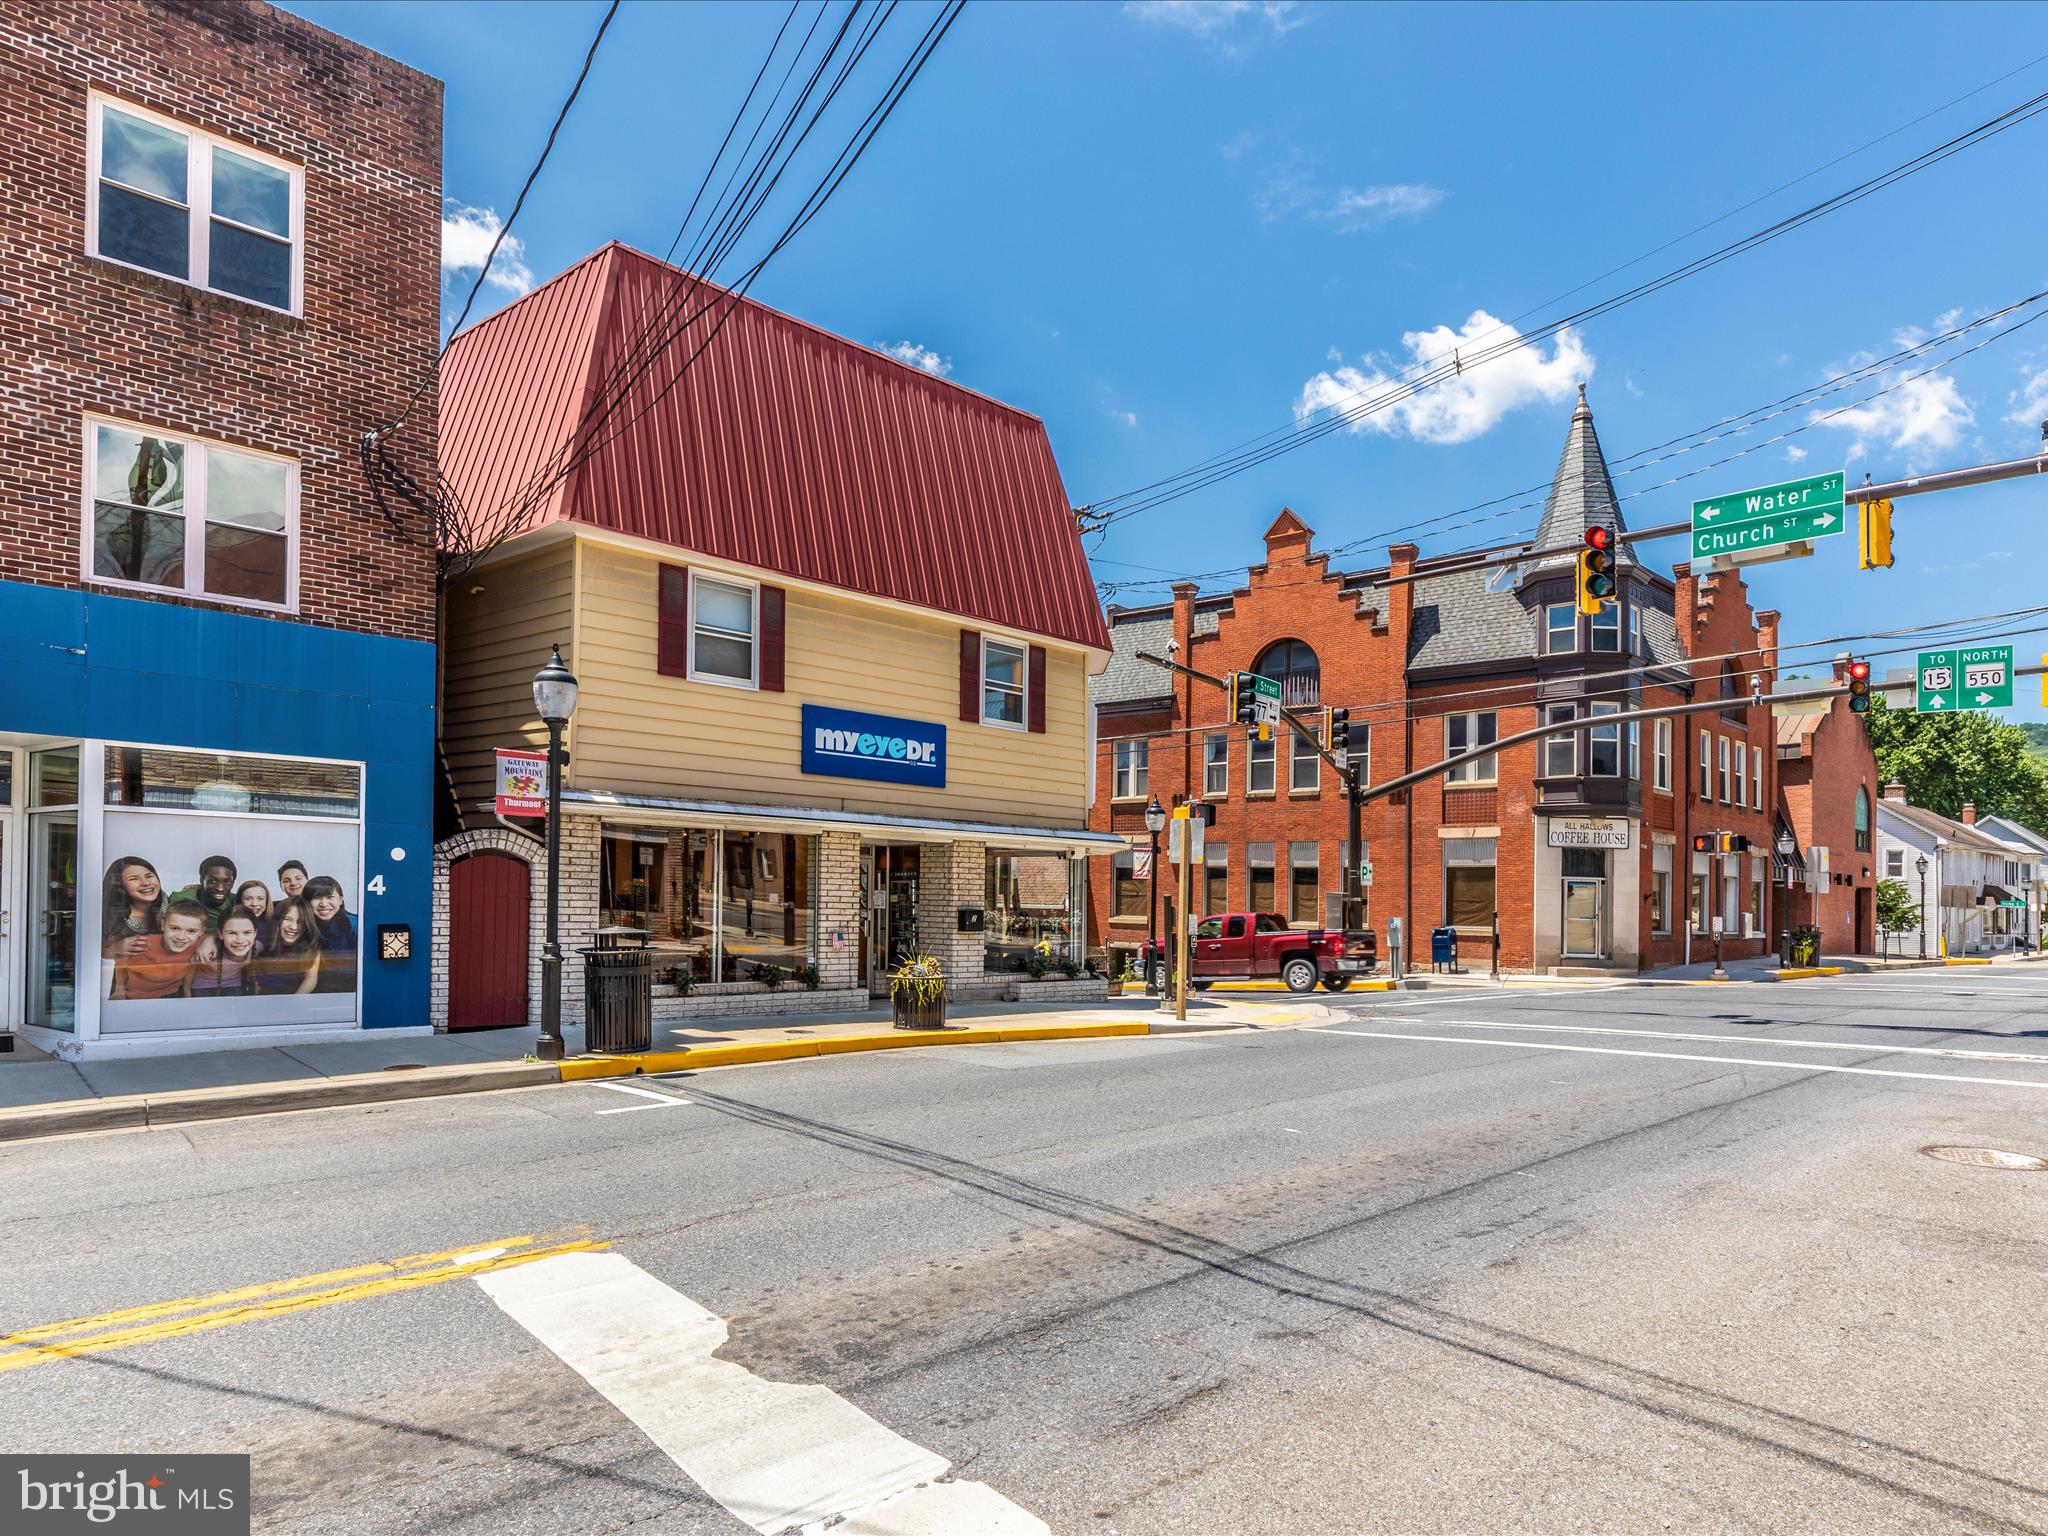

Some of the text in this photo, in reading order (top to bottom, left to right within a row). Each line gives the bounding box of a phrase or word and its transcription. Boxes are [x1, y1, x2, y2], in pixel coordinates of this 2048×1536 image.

[1745, 479, 1838, 514] Water ST
[1698, 517, 1797, 551] Church ST
[1929, 655, 1946, 665] TO
[1962, 649, 2008, 662] NORTH
[1927, 672, 1947, 686] 15
[1969, 671, 2002, 687] 550
[1260, 680, 1278, 696] Street
[1255, 702, 1267, 720] 77
[507, 759, 539, 768] GATEWAY
[504, 766, 543, 778] MOUNTAINS
[504, 797, 542, 808] Thurmont
[1564, 821, 1577, 830] ALL
[1550, 831, 1626, 845] COFFEE HOUSE
[367, 874, 387, 896] 4
